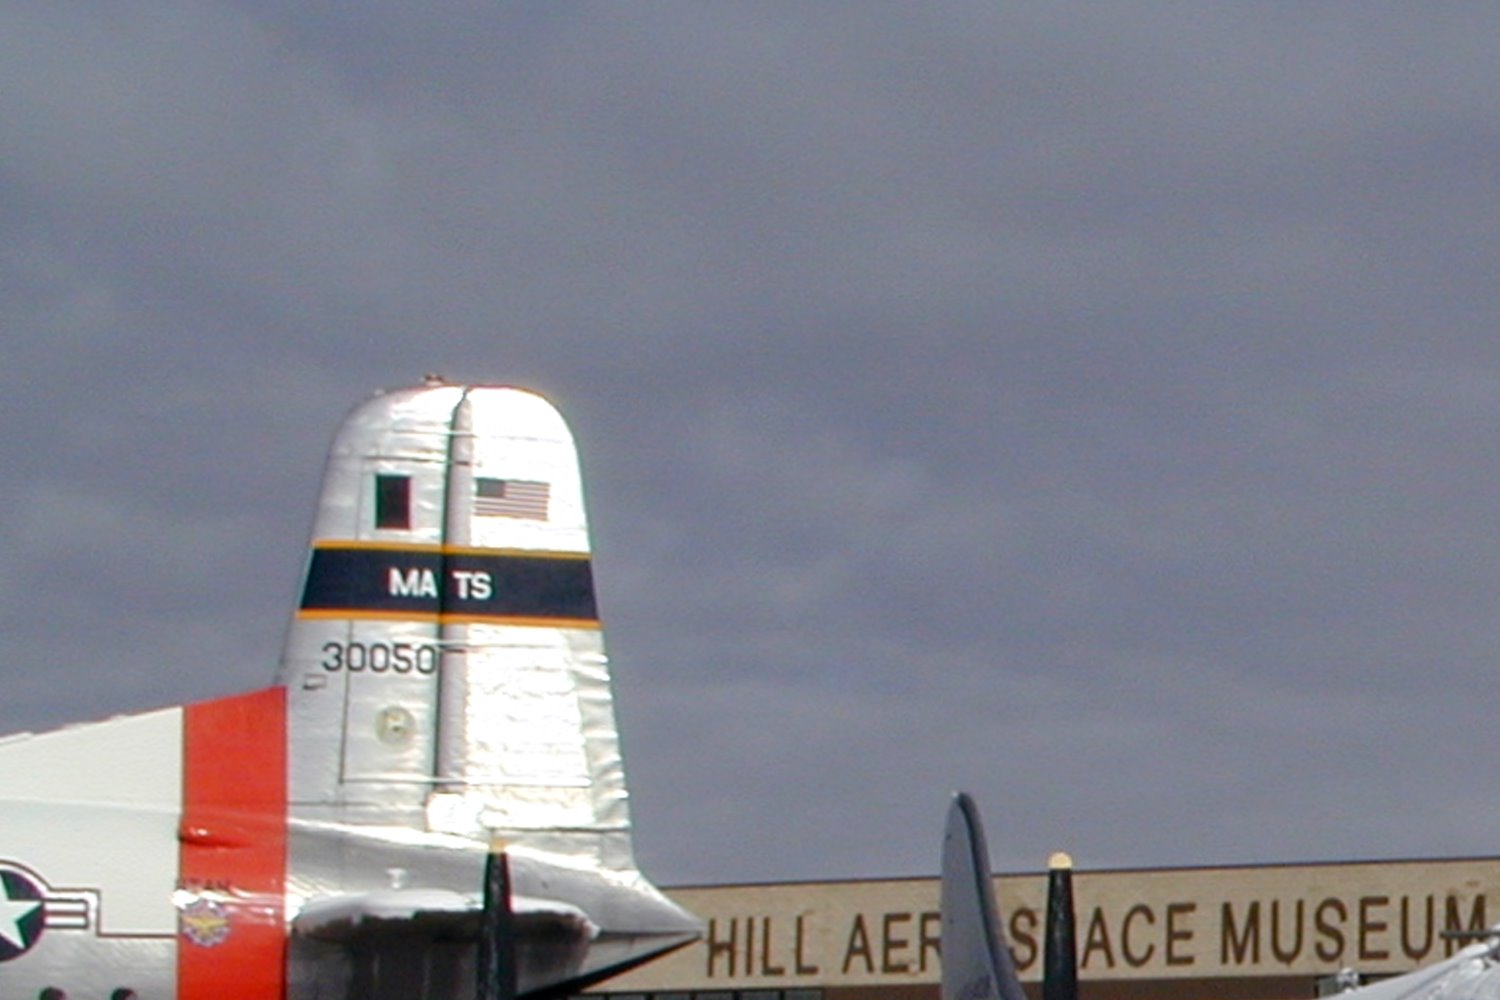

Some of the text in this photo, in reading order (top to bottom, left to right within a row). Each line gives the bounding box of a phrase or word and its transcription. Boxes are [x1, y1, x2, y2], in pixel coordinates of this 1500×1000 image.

[322, 642, 437, 674] 30050
[707, 894, 1486, 978] HILL AERSACE MUSEUM
